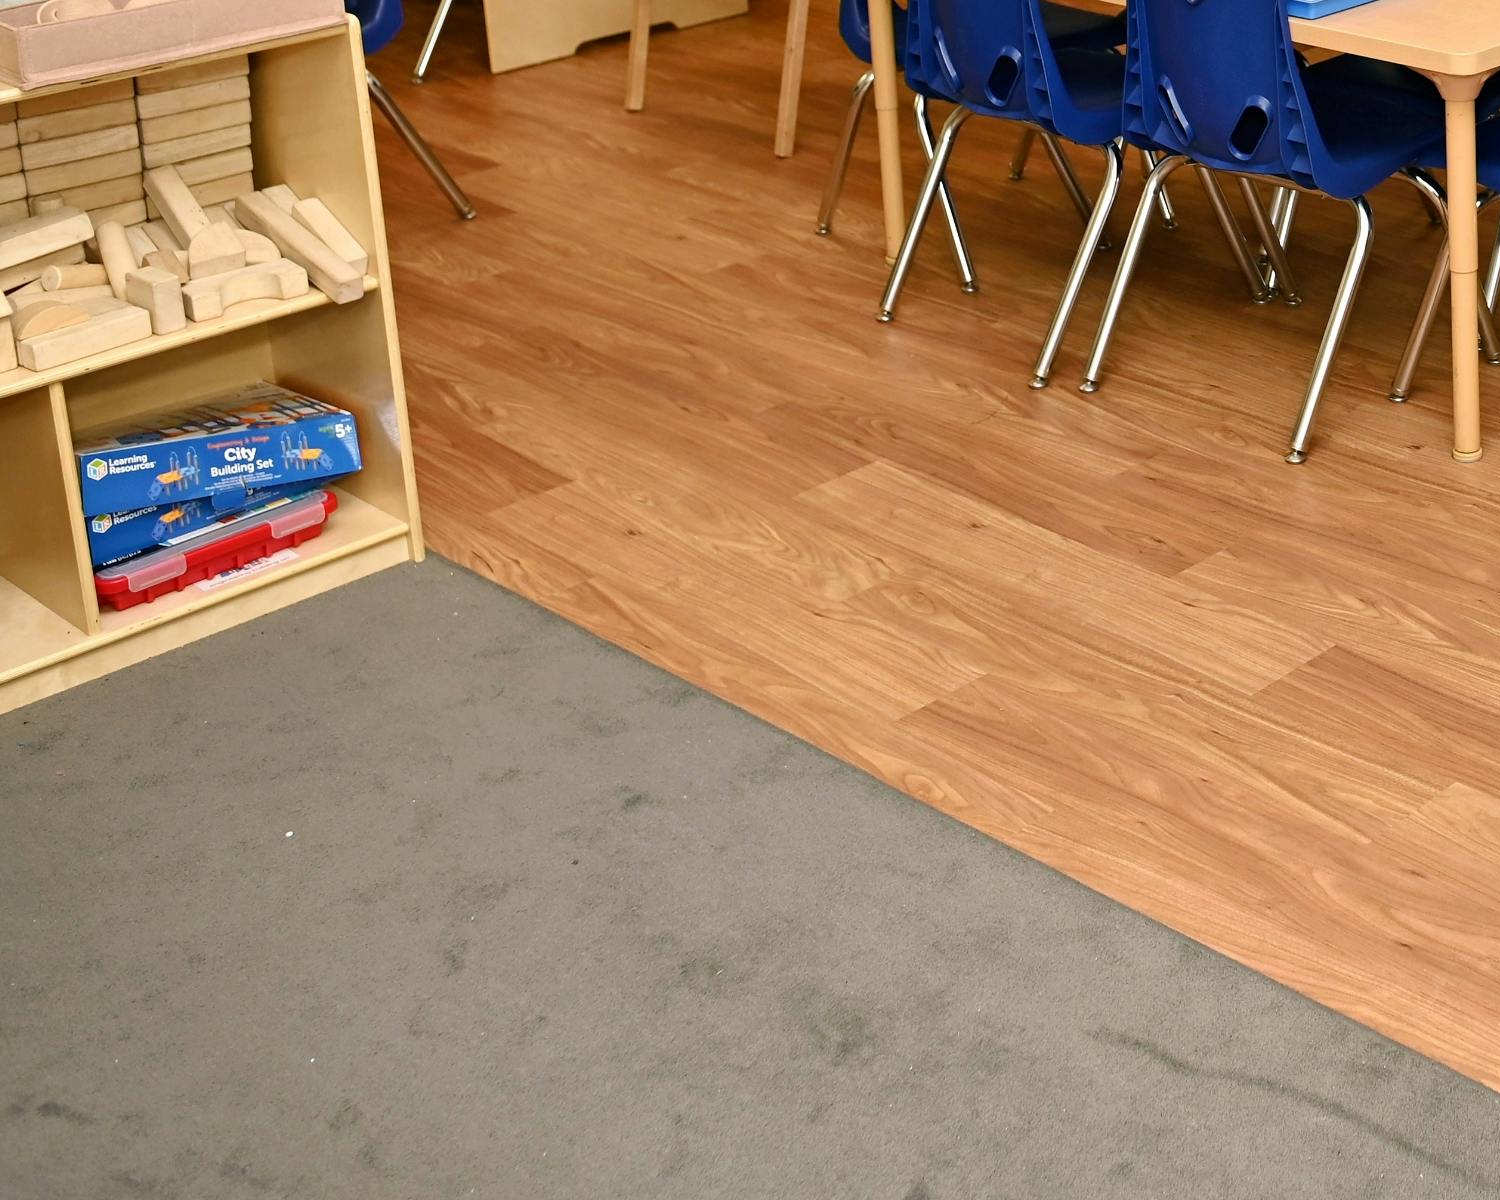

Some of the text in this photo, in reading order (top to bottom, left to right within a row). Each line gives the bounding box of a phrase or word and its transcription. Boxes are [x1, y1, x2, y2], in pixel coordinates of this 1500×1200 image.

[334, 423, 353, 439] 5+
[108, 454, 148, 467] Learning
[224, 446, 257, 462] City
[109, 461, 156, 475] Resources
[210, 458, 275, 477] Building Set
[113, 505, 157, 525] Resources
